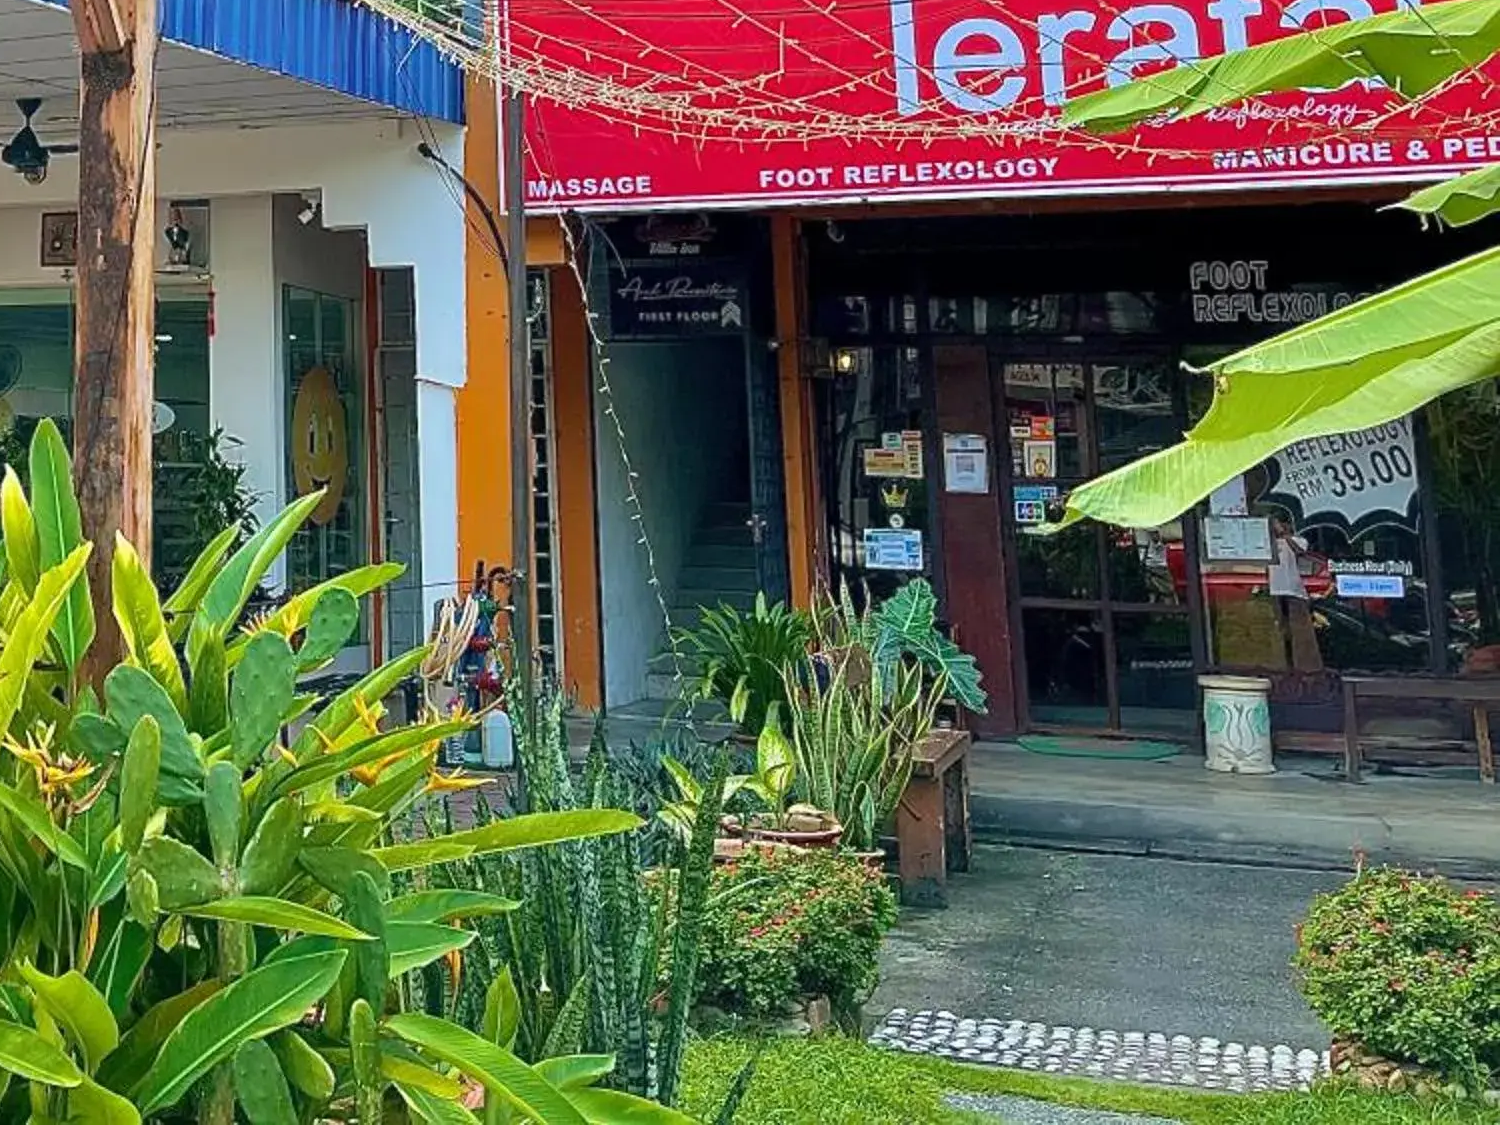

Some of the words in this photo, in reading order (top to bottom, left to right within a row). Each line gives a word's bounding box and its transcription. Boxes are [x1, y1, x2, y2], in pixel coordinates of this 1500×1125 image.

[528, 175, 651, 198] MASSAGE
[759, 168, 833, 188] FOOT
[843, 156, 1059, 185] REFLEXOLOGY
[1211, 141, 1393, 170] MANICURE
[1406, 139, 1431, 161] &
[1190, 260, 1269, 290] FOOT
[638, 311, 672, 322] FIRST
[676, 311, 719, 322] FLOOR
[1284, 465, 1318, 484] FROM
[1296, 477, 1326, 500] RM
[1322, 443, 1414, 498] 39.00
